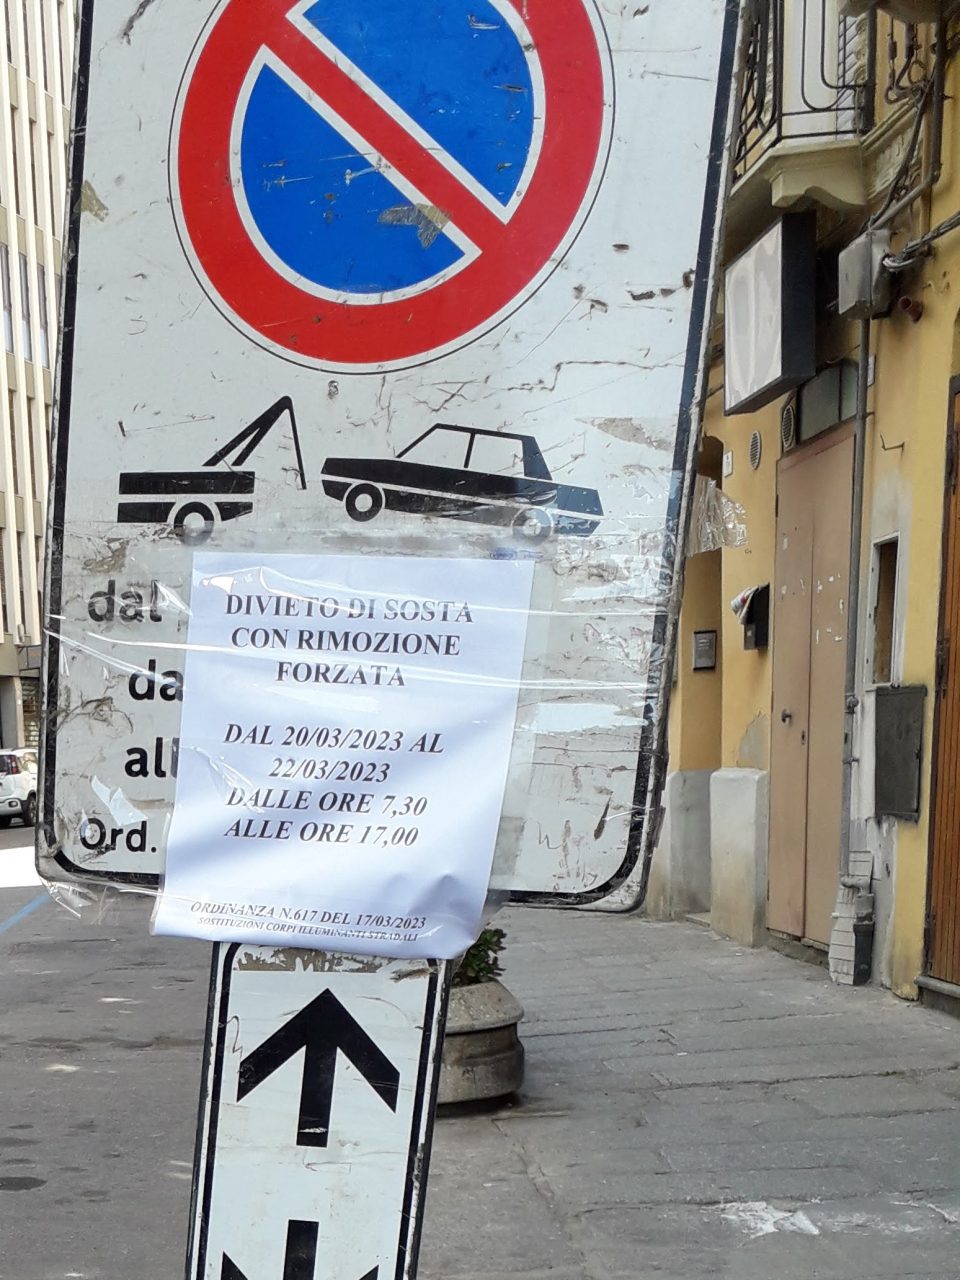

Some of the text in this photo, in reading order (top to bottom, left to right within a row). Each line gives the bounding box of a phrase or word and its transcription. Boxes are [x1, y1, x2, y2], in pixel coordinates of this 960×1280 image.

[87, 579, 163, 622] dal
[226, 594, 474, 623] DIVIETO DI SOSTA
[231, 627, 461, 656] CON RIMOZIONE
[275, 661, 405, 686] FORZATA
[223, 723, 445, 753] DAL 20/03/2023 AL
[268, 757, 390, 783] 22/03/2023
[224, 786, 428, 818] DALLE ORE 7,30
[80, 817, 157, 853] Ord.
[224, 818, 419, 848] ALLE ORE 17,00
[190, 901, 427, 929] ORDINANZA N.617 DEL 17/03/2023
[198, 917, 265, 930] SOSTITUZIONI
[266, 922, 297, 933] CORPI
